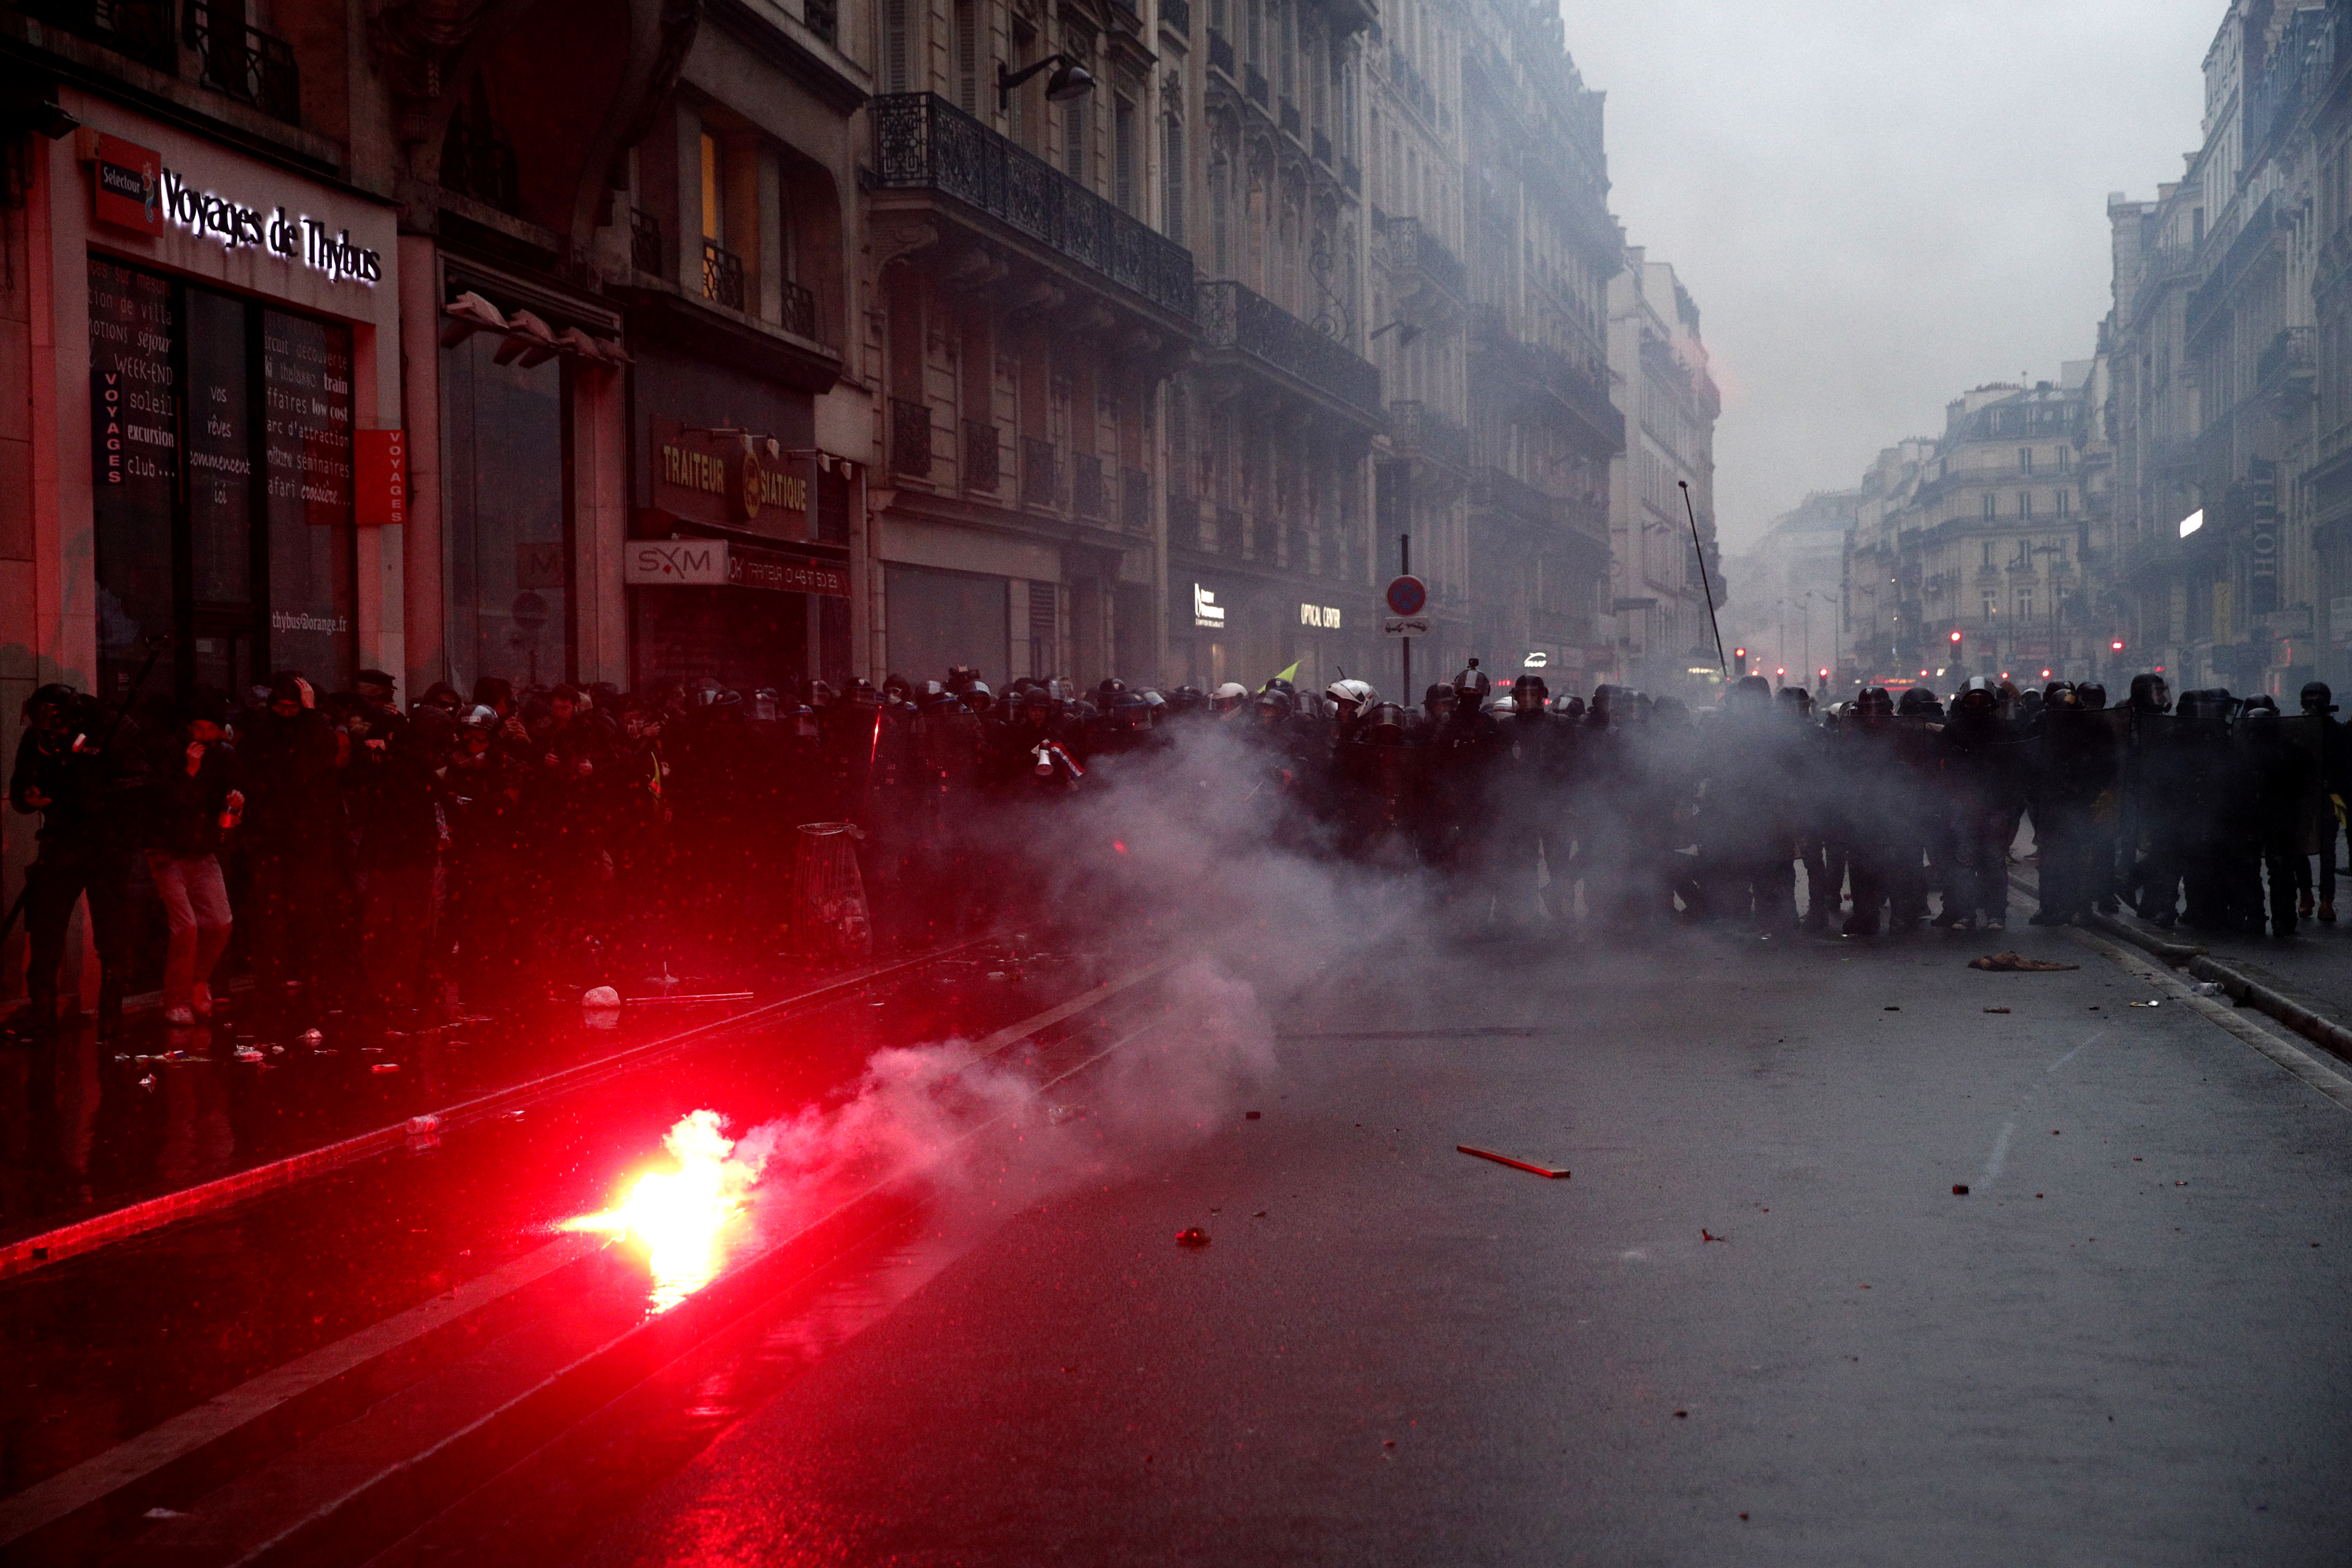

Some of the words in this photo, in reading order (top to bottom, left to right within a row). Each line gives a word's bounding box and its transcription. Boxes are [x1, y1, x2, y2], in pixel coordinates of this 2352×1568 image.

[103, 166, 140, 194] Selectour
[162, 168, 264, 249] Voyages
[269, 206, 299, 257] de
[302, 218, 382, 283] Thybus
[114, 266, 129, 286] sur
[137, 273, 172, 297] mesure
[120, 294, 133, 315] de
[141, 302, 172, 326] villa
[137, 328, 172, 357] séjour
[114, 353, 173, 386] WEEK-END
[280, 361, 316, 388] thalasso
[324, 372, 348, 395] train
[130, 391, 174, 416] soleil
[312, 398, 328, 416] low
[329, 405, 349, 422] cost
[104, 373, 122, 484] VOYAGES
[127, 424, 175, 448] excursion
[207, 413, 232, 438] rêves
[267, 420, 283, 434] arc
[288, 421, 349, 447] d'attraction
[266, 445, 292, 468] oiture
[297, 452, 350, 479] séminaires
[663, 445, 725, 493] TRAITEUR
[268, 476, 295, 498] afari
[389, 432, 403, 522] VOYAGES
[214, 481, 228, 504] ici
[2254, 470, 2275, 577] HOTEL
[748, 562, 782, 582] TRAITEUR
[272, 610, 347, 636] thybus@orange.fr
[1301, 603, 1322, 627] OPTICAL
[1323, 606, 1341, 629] CENTER
